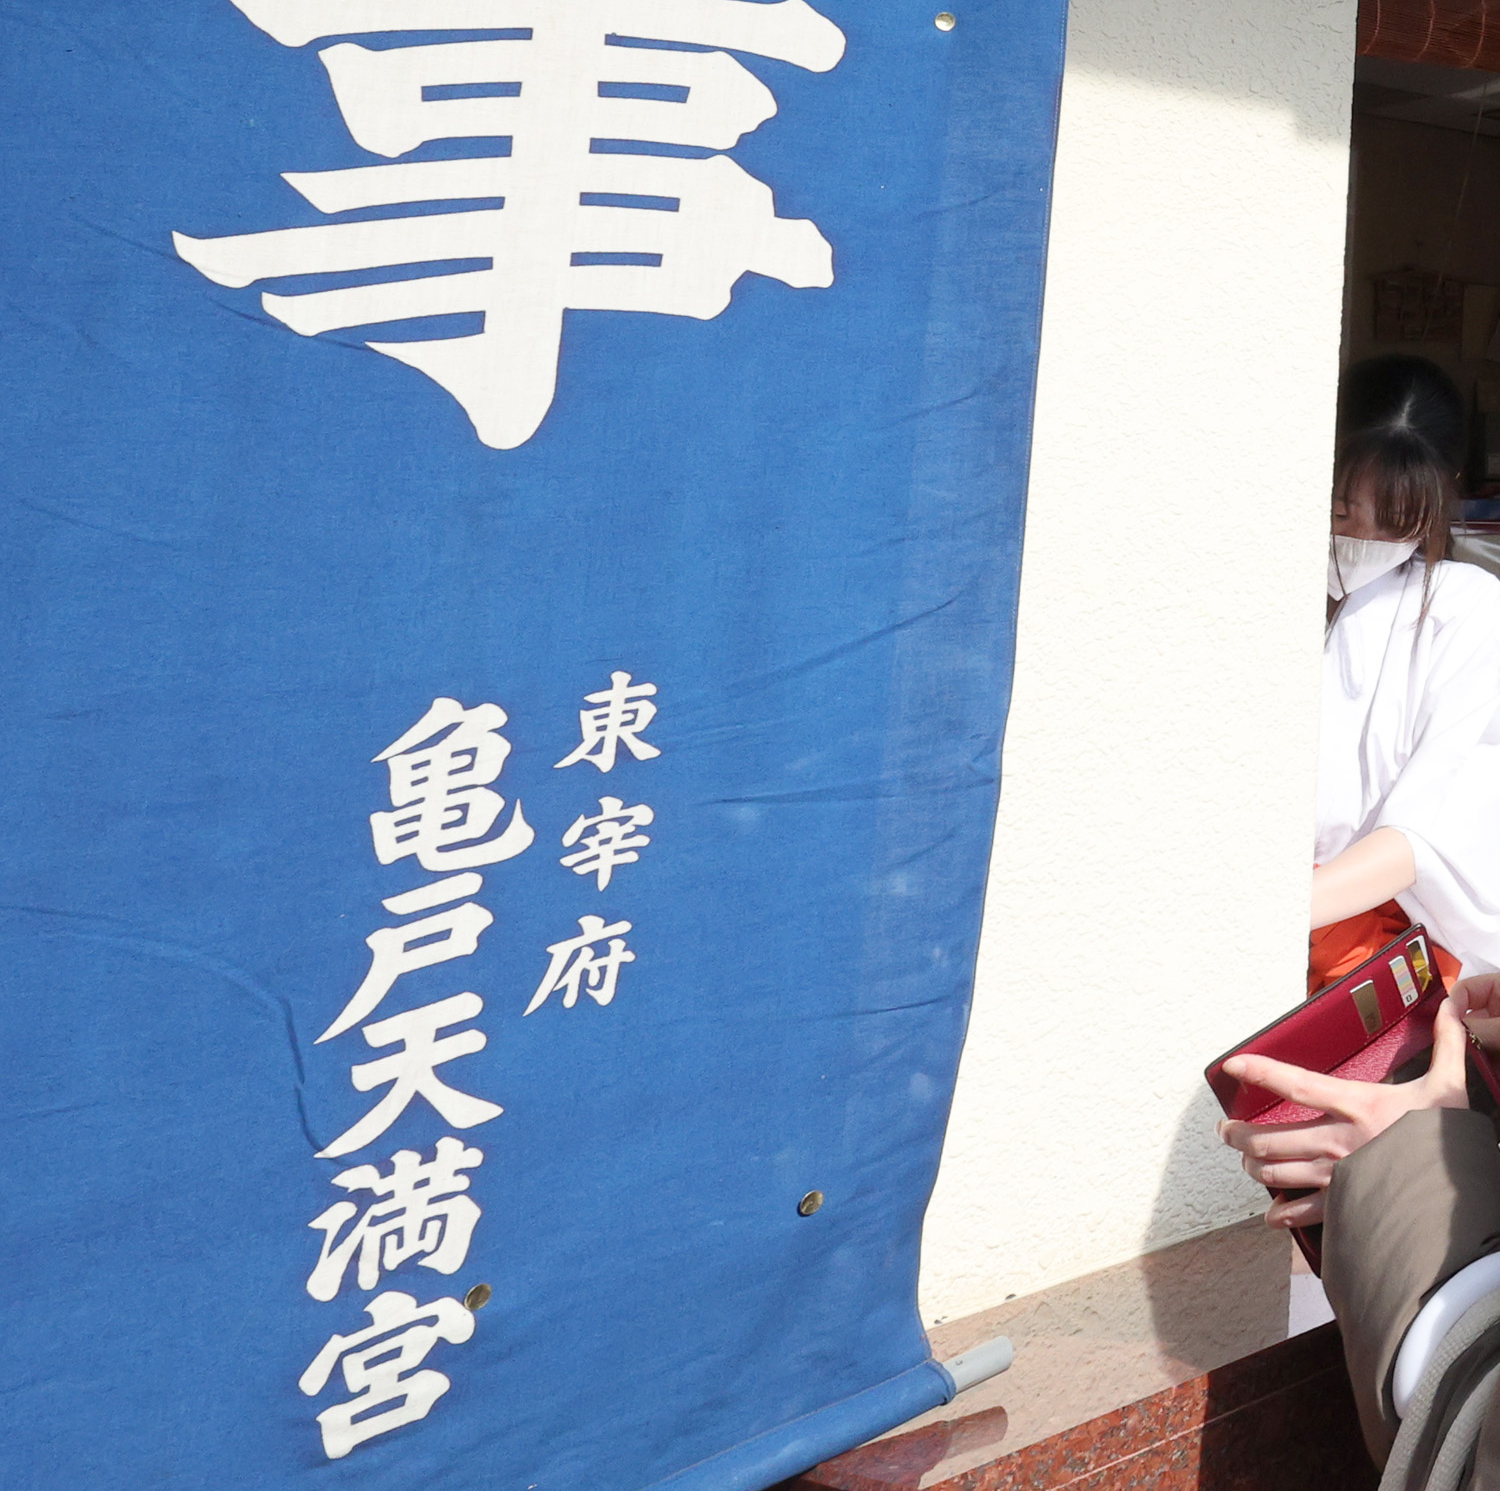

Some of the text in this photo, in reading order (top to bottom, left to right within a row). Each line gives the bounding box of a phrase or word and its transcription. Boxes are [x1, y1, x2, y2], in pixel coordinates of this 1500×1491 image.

[299, 696, 535, 1460] 亀戸天満宮
[523, 669, 662, 1017] 東宰府
